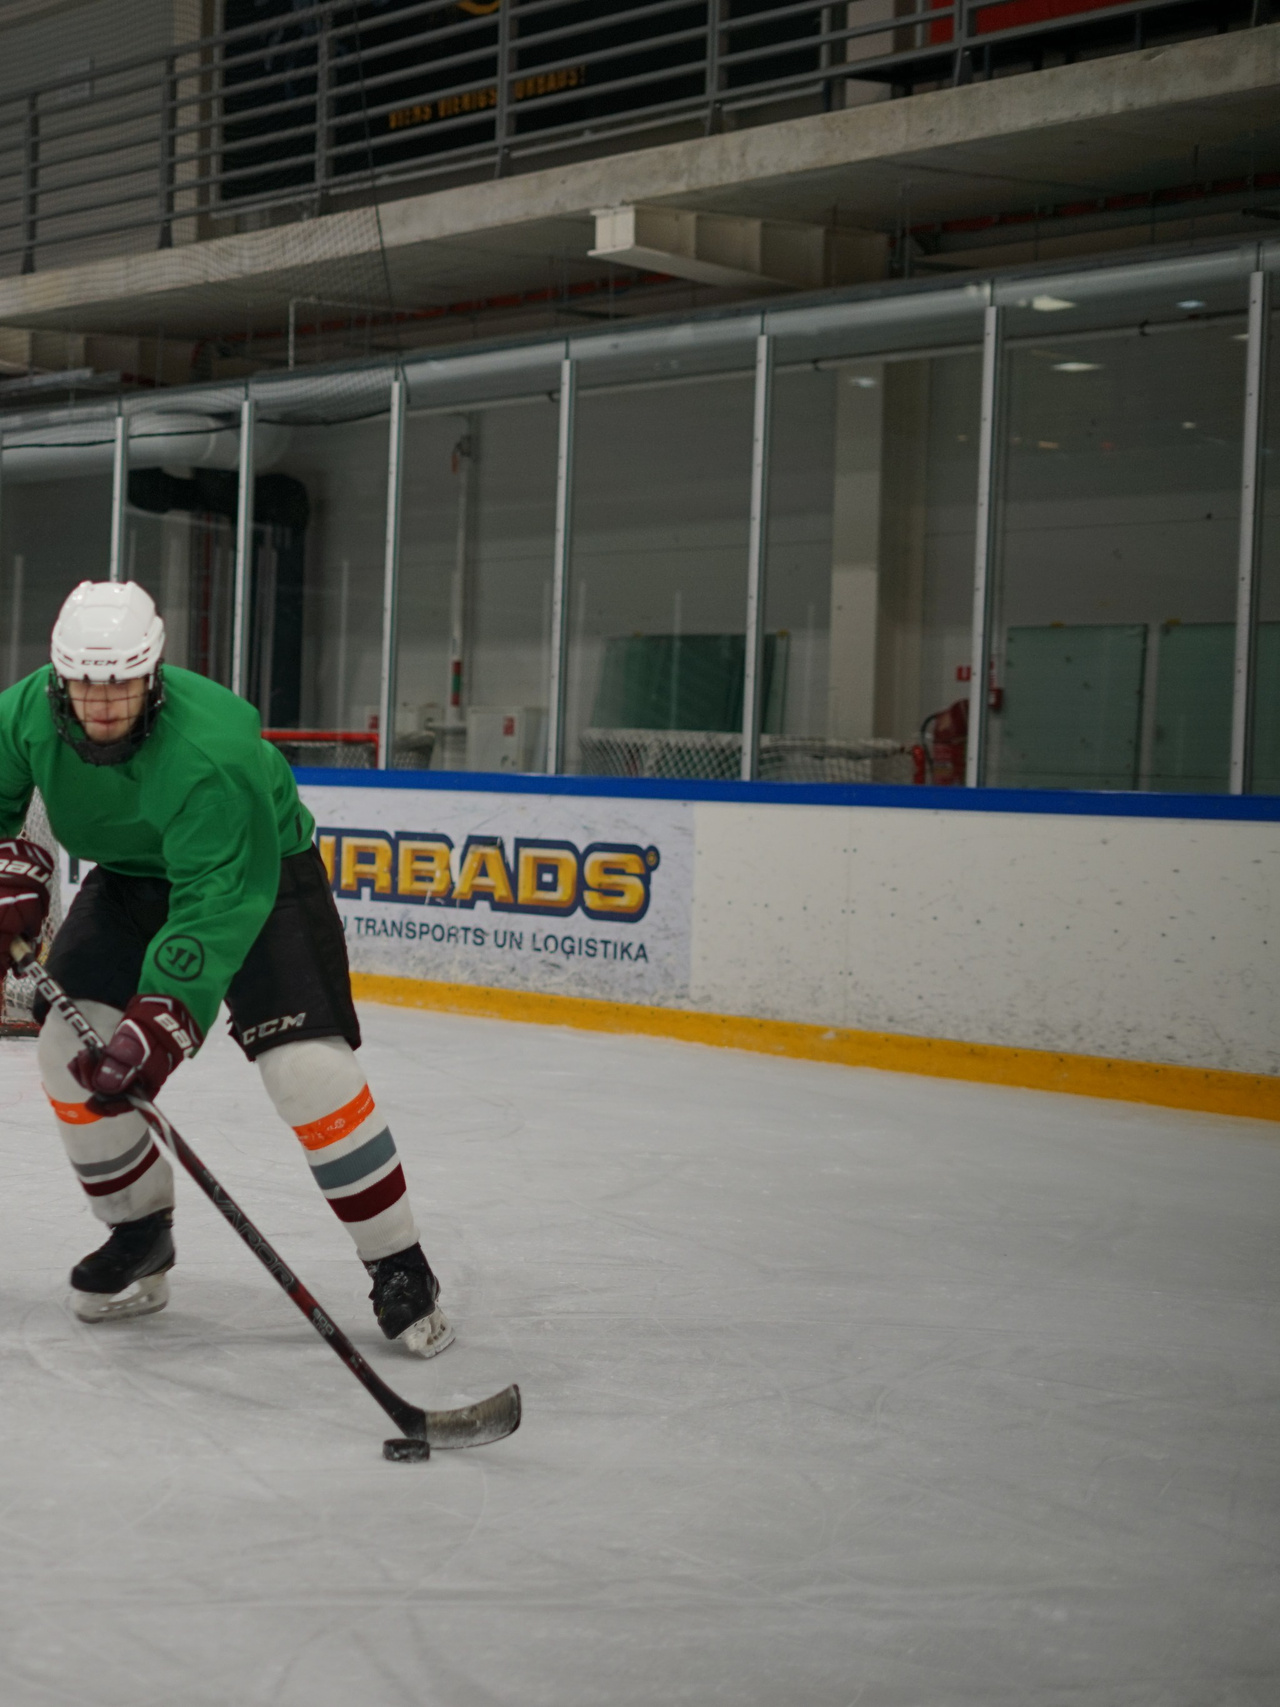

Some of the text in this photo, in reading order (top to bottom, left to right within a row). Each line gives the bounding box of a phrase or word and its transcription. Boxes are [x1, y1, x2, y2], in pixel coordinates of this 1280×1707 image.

[81, 659, 118, 667] CCM
[354, 916, 486, 947] TRANSPORTS
[494, 931, 524, 950] UN
[532, 933, 649, 967] LOĢISTIKA
[23, 959, 107, 1052] BAUER
[242, 1012, 307, 1047] CCM
[212, 1184, 295, 1292] VAPOR
